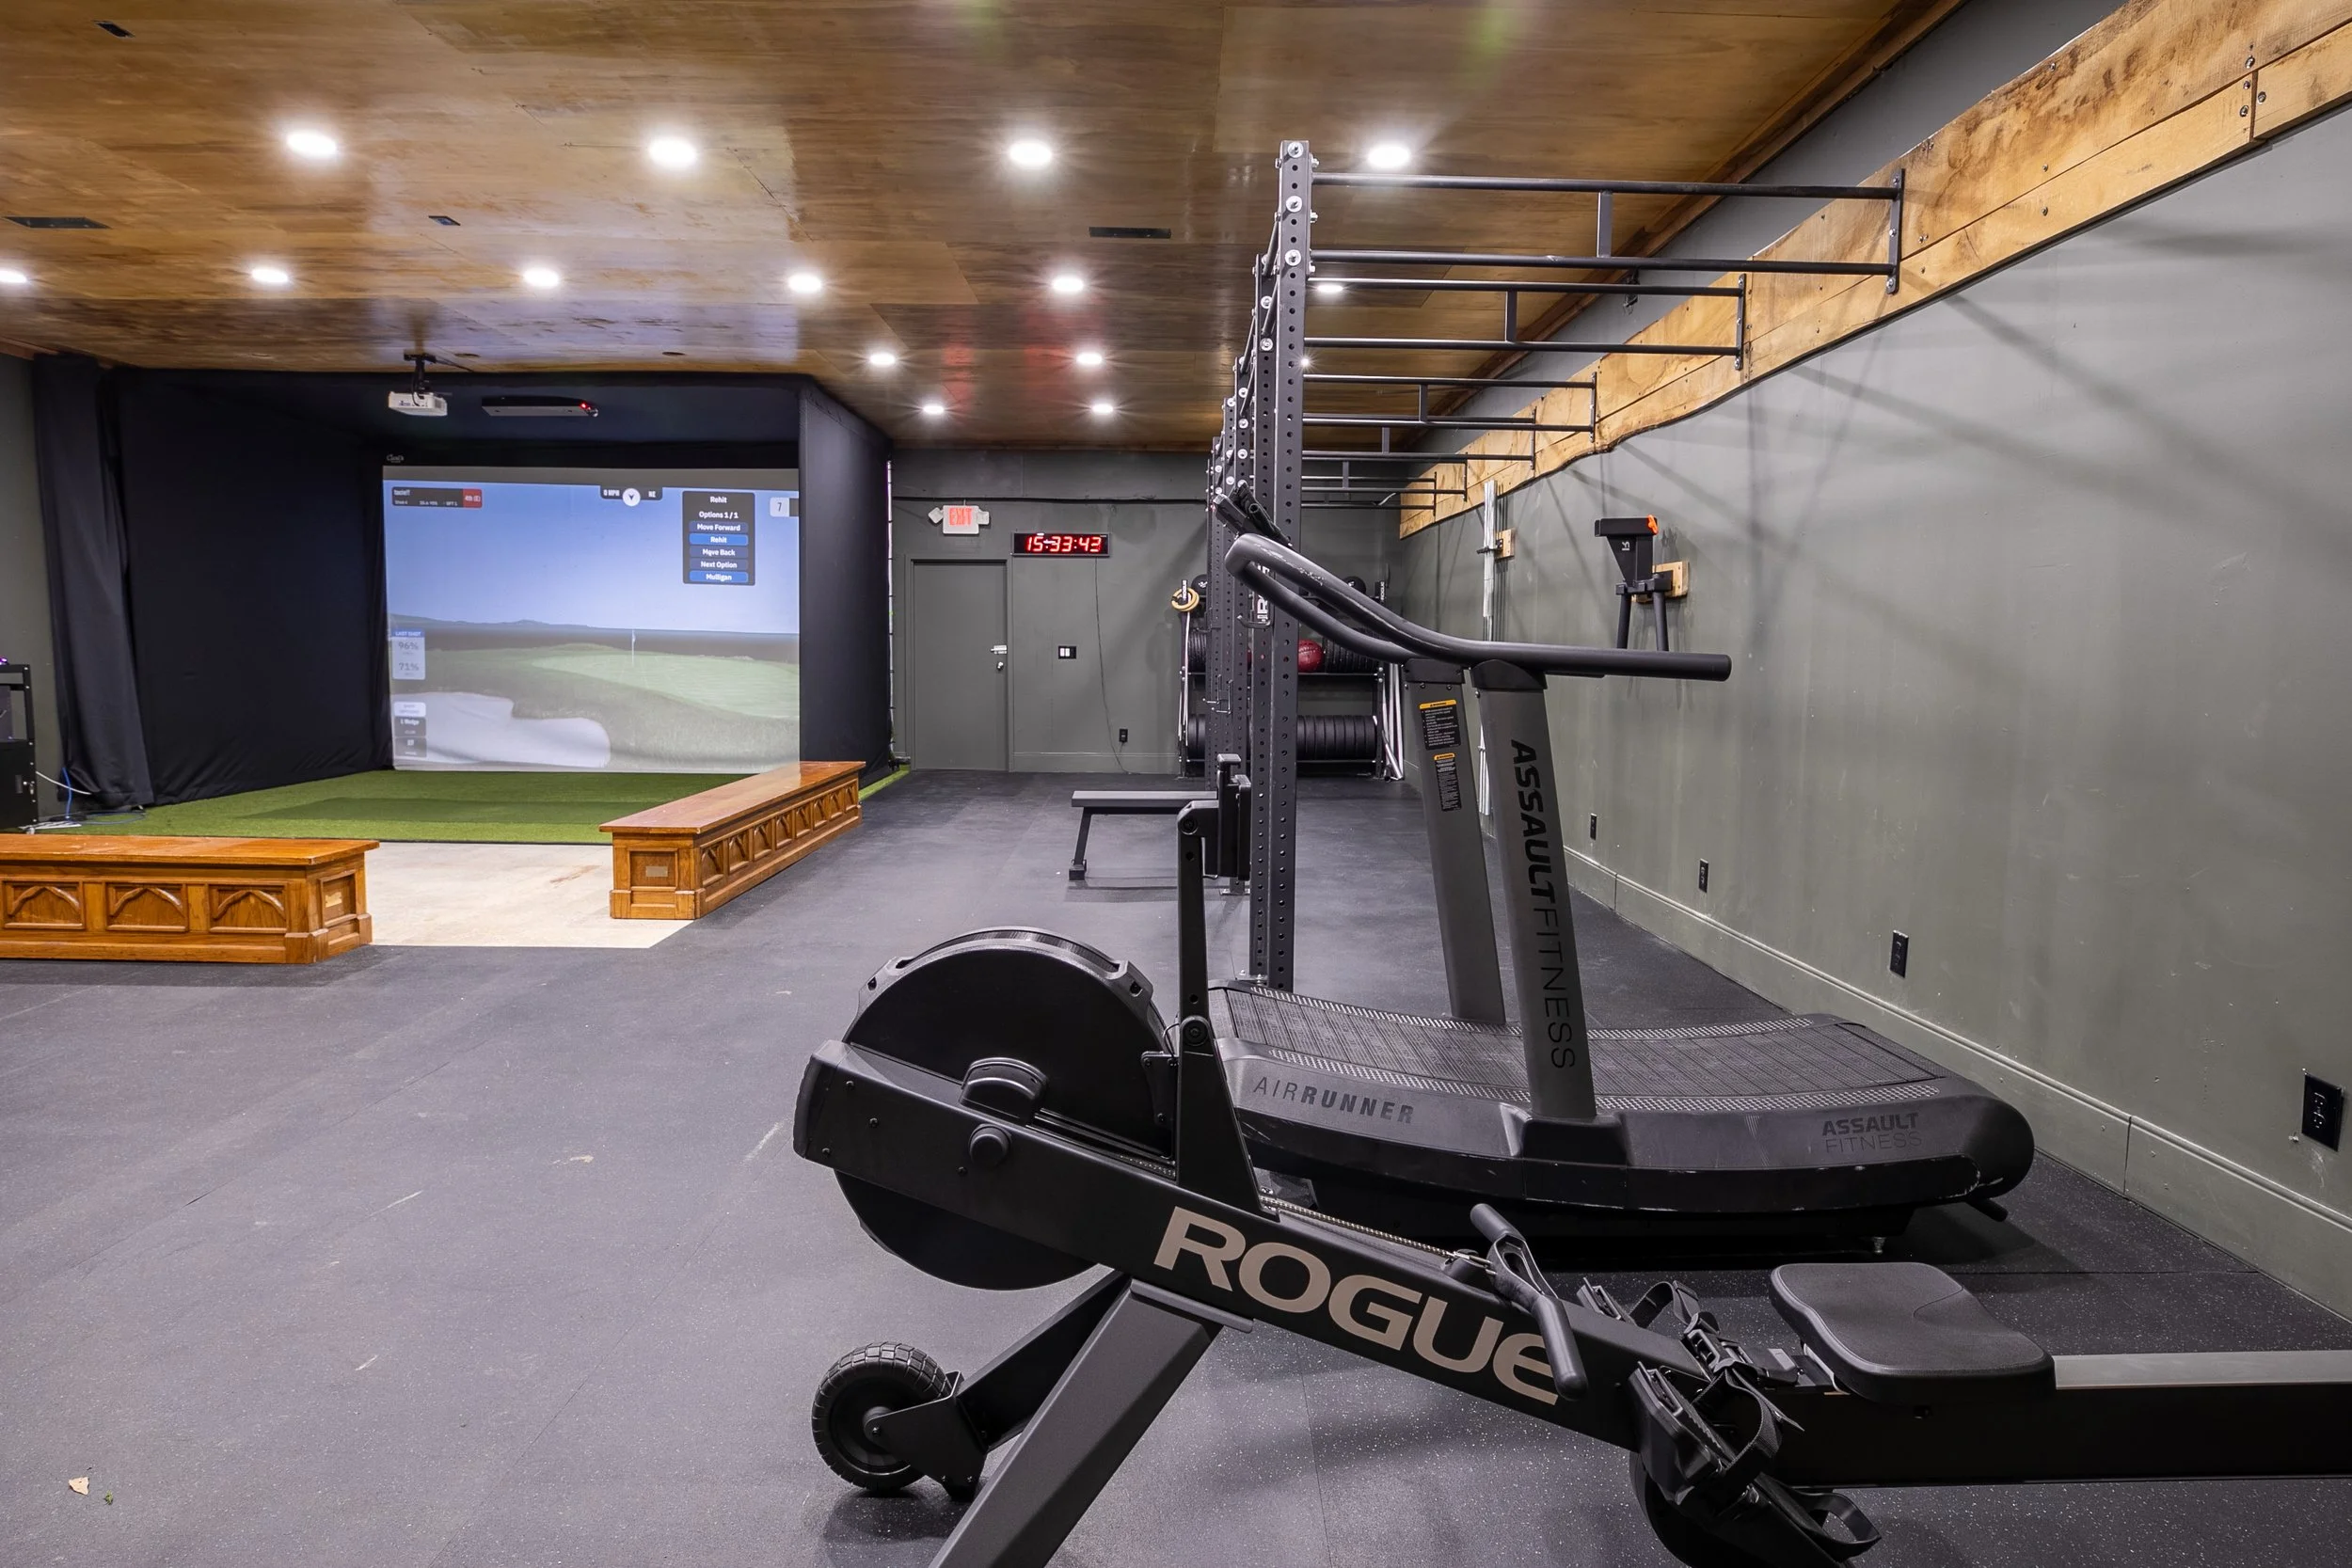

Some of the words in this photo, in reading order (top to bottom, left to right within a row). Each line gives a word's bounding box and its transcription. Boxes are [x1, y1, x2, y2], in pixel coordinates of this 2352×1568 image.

[777, 501, 782, 512] 7
[698, 511, 723, 519] Options
[948, 507, 973, 526] EXIT
[716, 561, 738, 569] Option
[706, 573, 733, 581] Mulligan
[1821, 1112, 1919, 1136] ASSAULT
[1825, 1131, 1922, 1153] FITNESS
[1153, 1206, 1559, 1406] ROGUE
